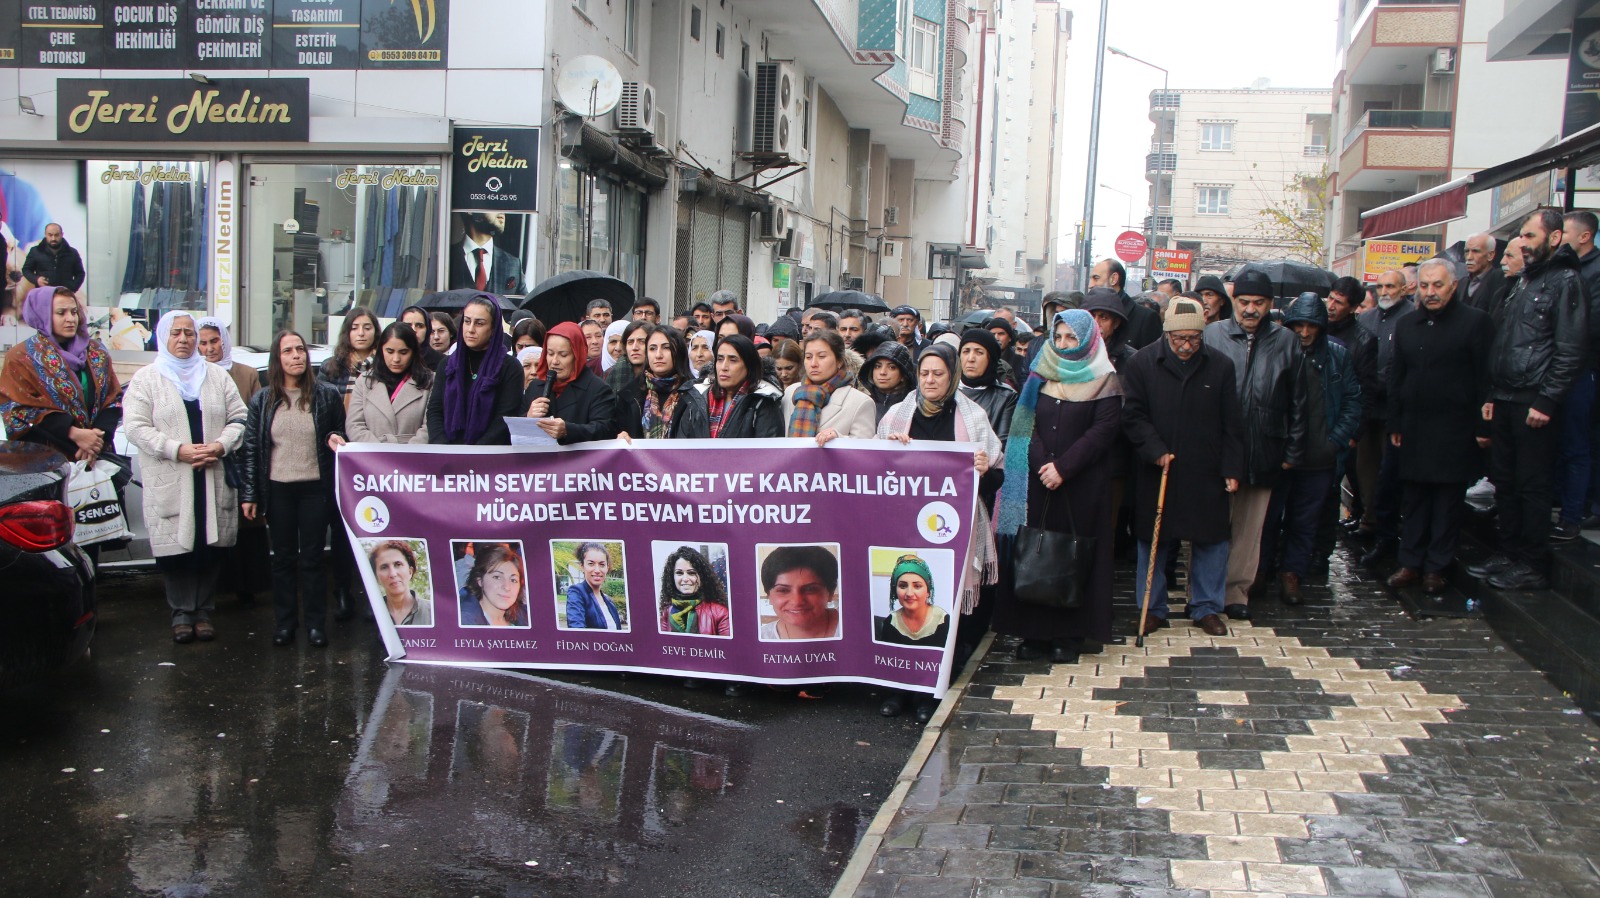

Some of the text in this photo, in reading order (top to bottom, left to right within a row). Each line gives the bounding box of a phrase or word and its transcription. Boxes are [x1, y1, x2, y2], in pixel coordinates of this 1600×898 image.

[28, 5, 97, 21] (TEL TEDAVİSİ)
[114, 3, 178, 26] ÇOCUK DİŞ
[291, 9, 343, 23] TASARIMI
[196, 14, 265, 37] GÖMÜK DİŞ
[49, 31, 76, 47] ÇENE
[115, 29, 177, 49] HEKİMLİĞİ
[295, 32, 337, 48] ESTETİK
[39, 50, 86, 64] BOTOKSU
[197, 39, 262, 60] ÇEKİMLERİ
[381, 50, 438, 60] 0553 309 84 70
[298, 51, 333, 65] DOLGU
[68, 89, 292, 134] Terzi Nedim
[463, 135, 528, 173] Terzi Nedim
[100, 164, 192, 186] Terzi Nedim
[337, 168, 439, 190] Terzi Nedim
[1401, 244, 1431, 255] EMLAK
[352, 467, 958, 497] SAKİNE'LERİN SEVE'LERİN CESARET VE KARARLILIĞIYLA
[78, 503, 120, 523] ŞENLEN
[476, 498, 812, 524] MÜCADELEYE DEVAM EDİYORUZ
[454, 638, 538, 650] LEYLA ŞAYLEMEZ
[555, 640, 634, 653] FİDAN DOĞAN
[662, 645, 727, 660] SEVE DEMİR
[763, 652, 837, 664] FATMA UYAR
[874, 654, 911, 670] PAKİZE
